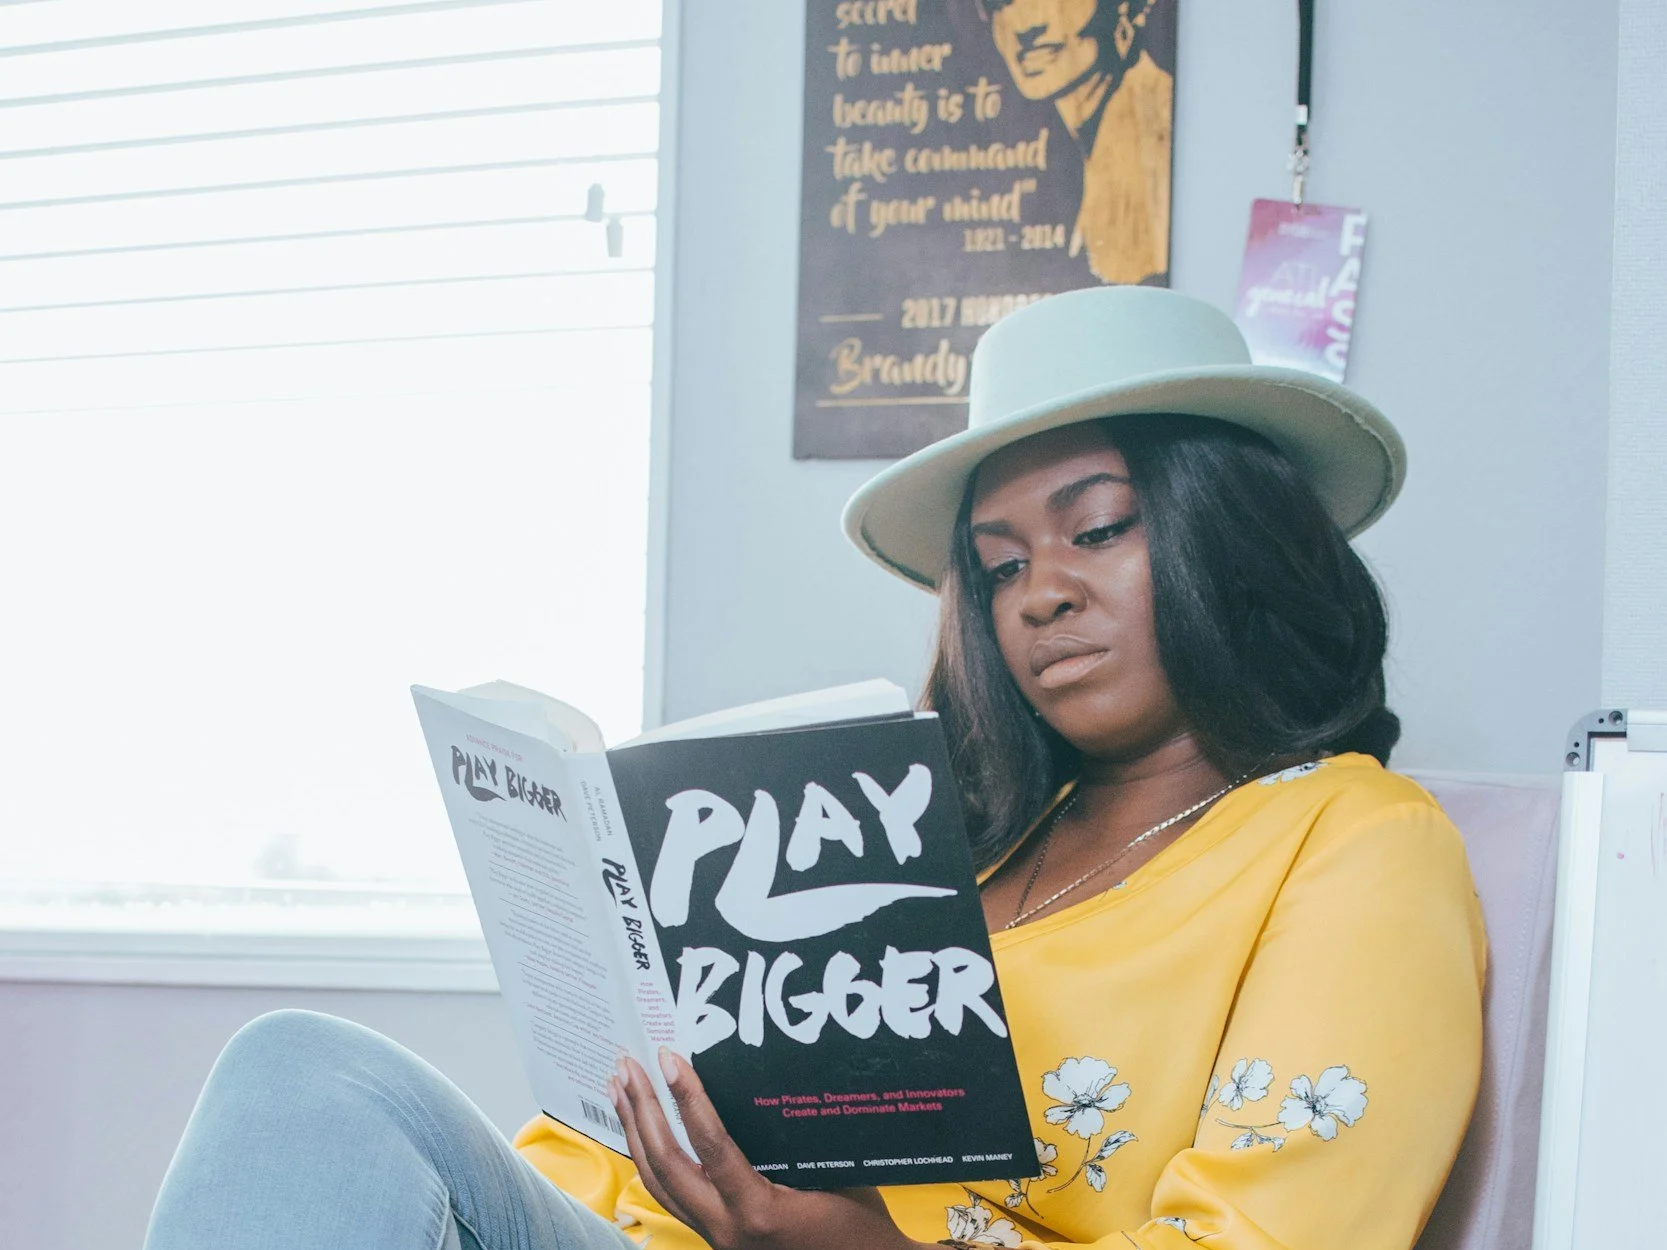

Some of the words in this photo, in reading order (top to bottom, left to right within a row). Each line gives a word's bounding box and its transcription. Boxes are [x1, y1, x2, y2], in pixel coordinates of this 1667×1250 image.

[827, 36, 862, 81] to
[870, 42, 952, 74] inner
[833, 81, 928, 134] beauty
[936, 88, 964, 123] is
[965, 76, 1001, 122] to
[826, 137, 898, 183] take
[904, 127, 1049, 173] command
[830, 181, 868, 234] of
[869, 196, 936, 238] your
[901, 296, 957, 328] 2017
[829, 337, 967, 396] Brandy
[451, 745, 507, 802] PLAY
[504, 765, 567, 823] BIGGER
[649, 763, 958, 943] PLAY
[601, 858, 638, 909] PLAY
[622, 916, 650, 970] BIGGER
[676, 944, 1008, 1055] BIGGER
[754, 1097, 779, 1106] How
[781, 1094, 822, 1104] Pirates,
[824, 1091, 880, 1103] Dreamers,
[883, 1090, 904, 1100] and
[905, 1088, 965, 1099] Innovators
[782, 1107, 818, 1118] Create
[820, 1105, 841, 1116] and
[842, 1103, 896, 1115] Dominate
[897, 1101, 943, 1112] Markets
[796, 1161, 816, 1170] DAVE
[816, 1160, 856, 1169] PETERSON
[862, 1157, 913, 1167] CHRISTOPHER
[913, 1156, 953, 1165] LOCHHEAD
[962, 1154, 985, 1163] KEVIN
[985, 1153, 1013, 1162] MANEY
